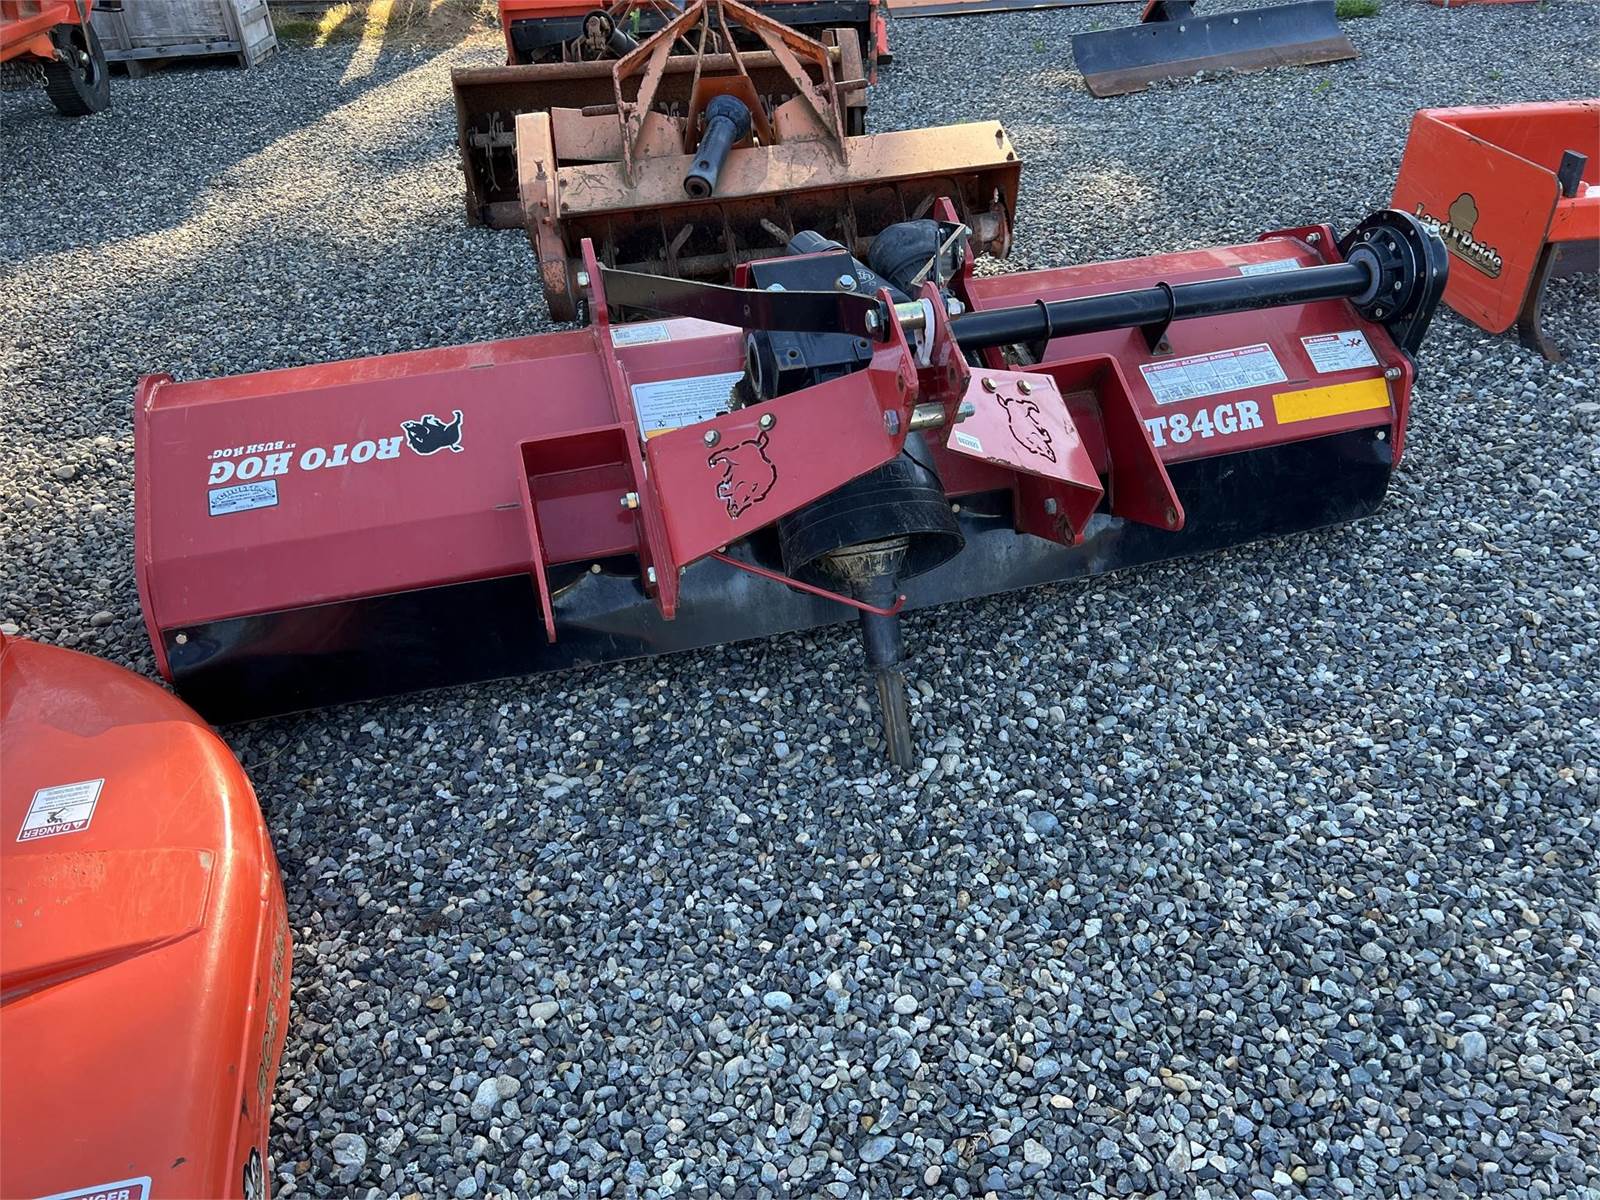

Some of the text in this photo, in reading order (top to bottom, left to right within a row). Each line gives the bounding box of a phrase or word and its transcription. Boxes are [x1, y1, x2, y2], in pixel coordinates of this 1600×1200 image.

[1458, 229, 1503, 270] Pride
[208, 436, 404, 485] ROTO HOG
[247, 440, 284, 454] BUSH
[22, 823, 70, 838] DANGER
